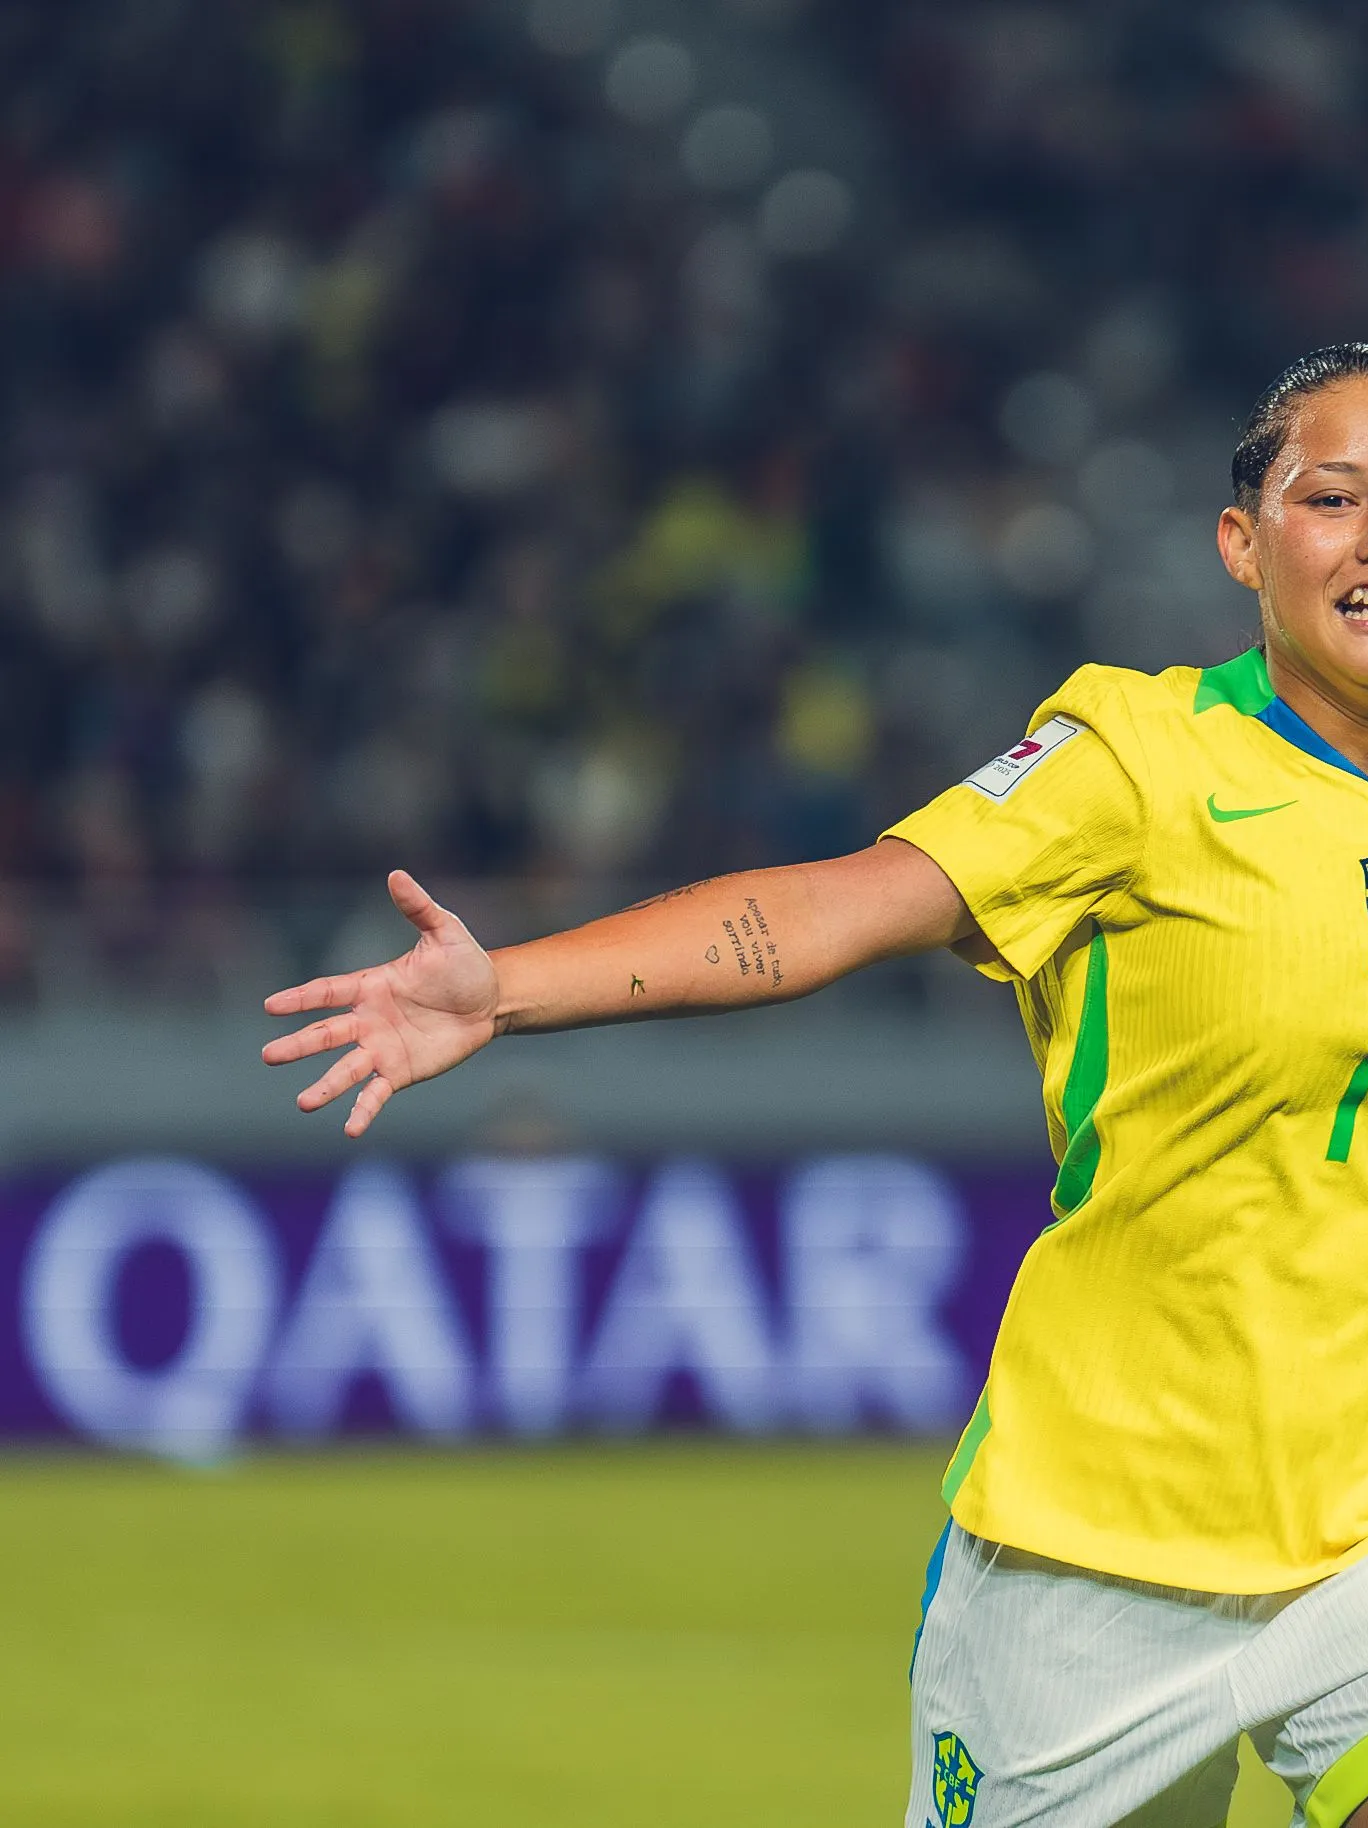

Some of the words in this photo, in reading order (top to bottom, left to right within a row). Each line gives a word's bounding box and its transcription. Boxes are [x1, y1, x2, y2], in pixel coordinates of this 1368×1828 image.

[722, 920, 752, 976] sorrindo
[739, 914, 753, 936] vou
[751, 940, 766, 975] viver
[18, 1154, 972, 1462] QATAR
[943, 1768, 960, 1790] CBF
